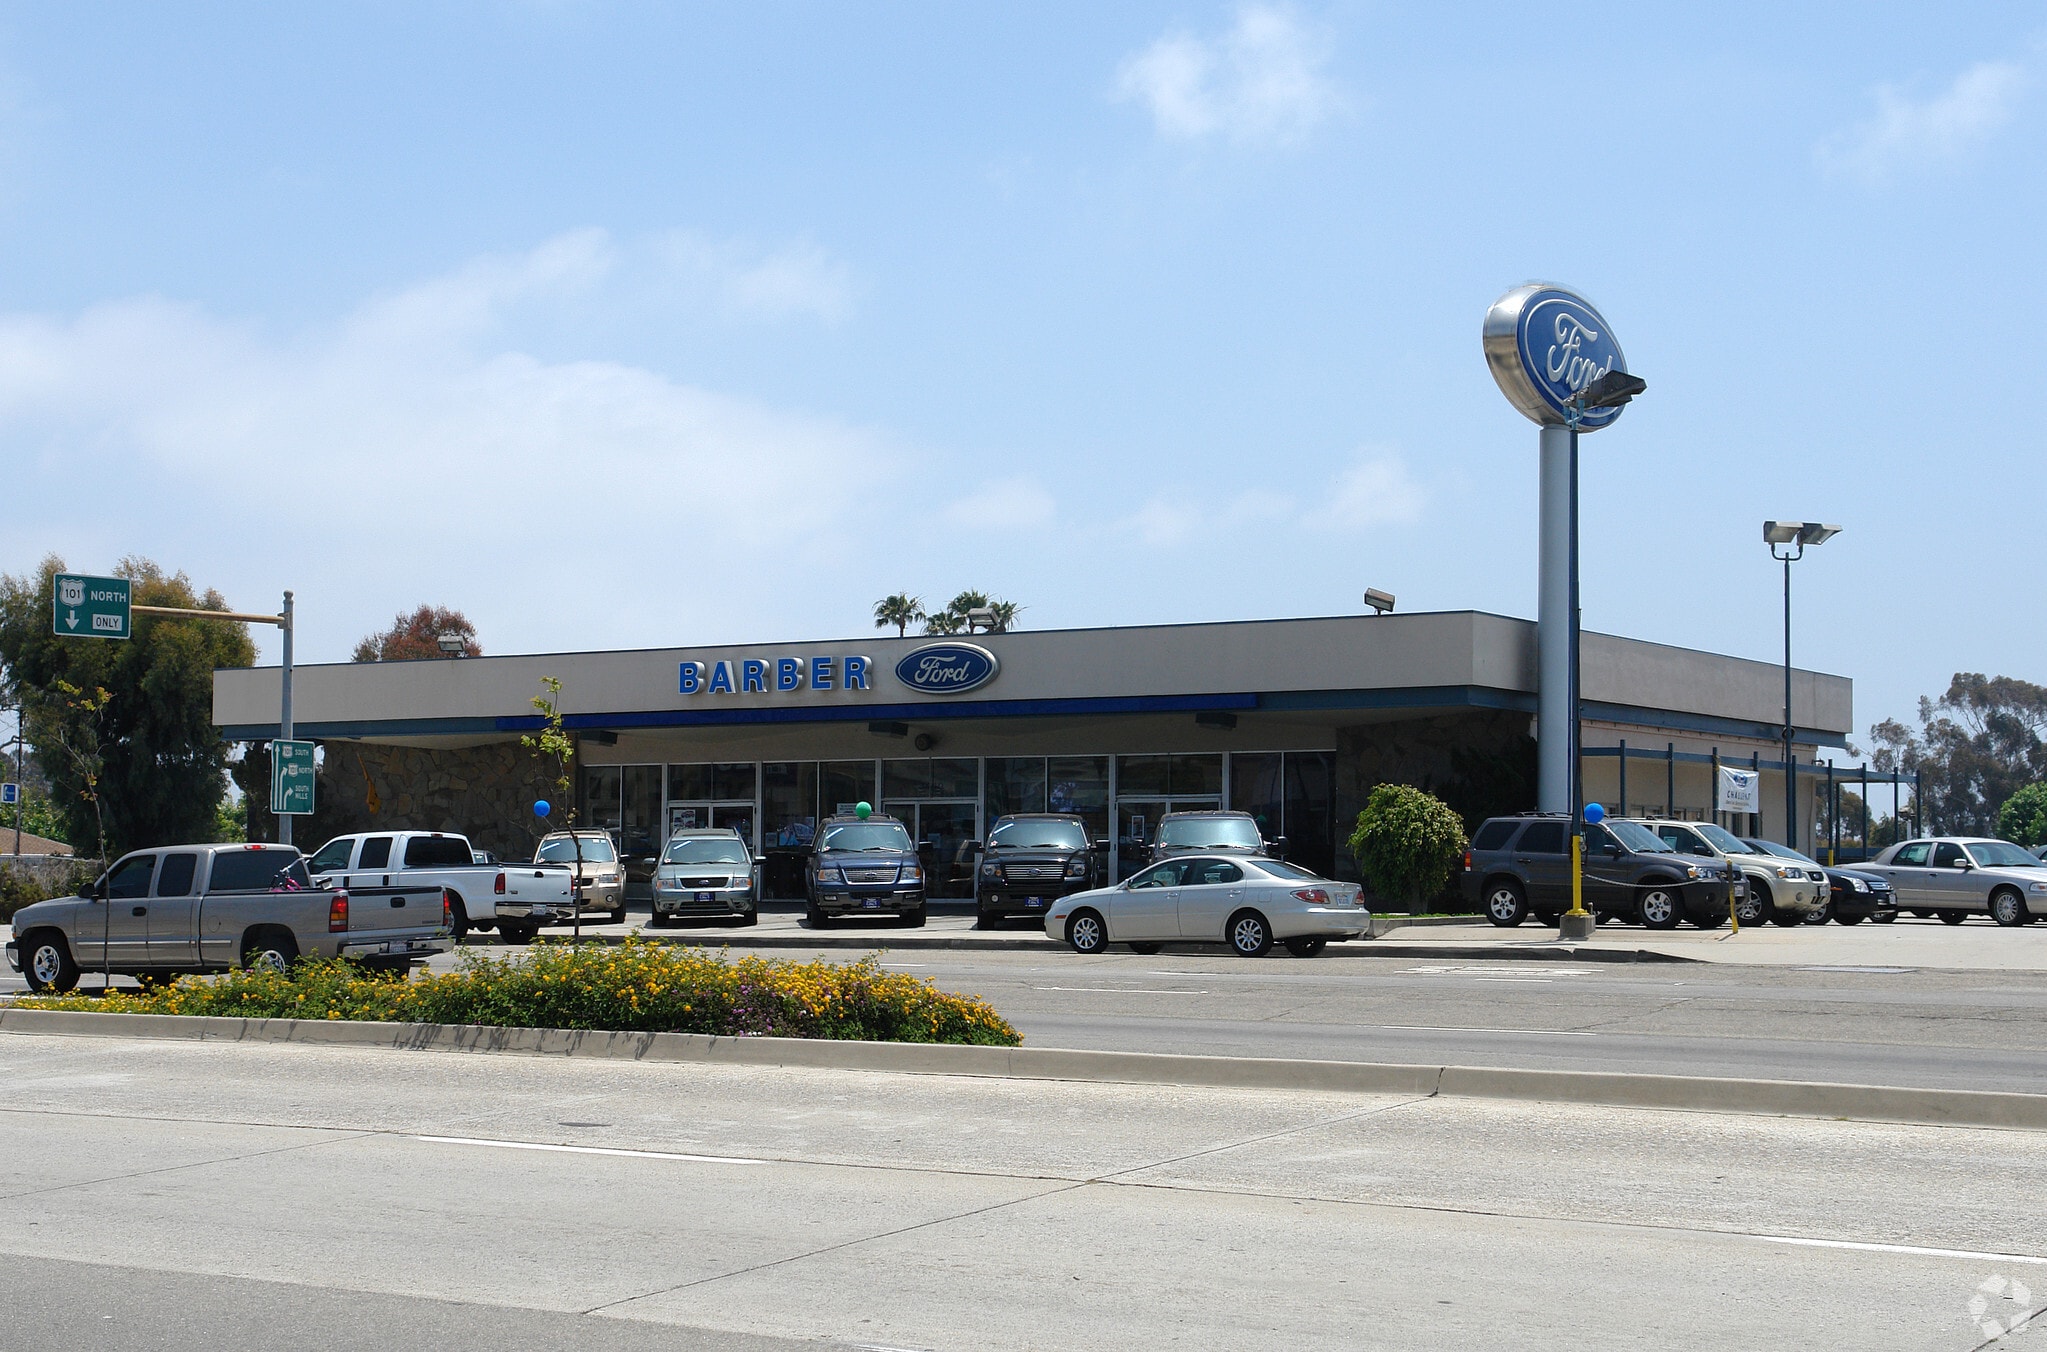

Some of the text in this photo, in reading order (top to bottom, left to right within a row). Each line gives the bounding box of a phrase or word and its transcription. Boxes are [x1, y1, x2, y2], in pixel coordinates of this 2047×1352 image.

[65, 588, 127, 602] 101 NORTH
[95, 616, 119, 628] ONLY
[679, 655, 872, 695] BARBER
[914, 655, 970, 683] Ford
